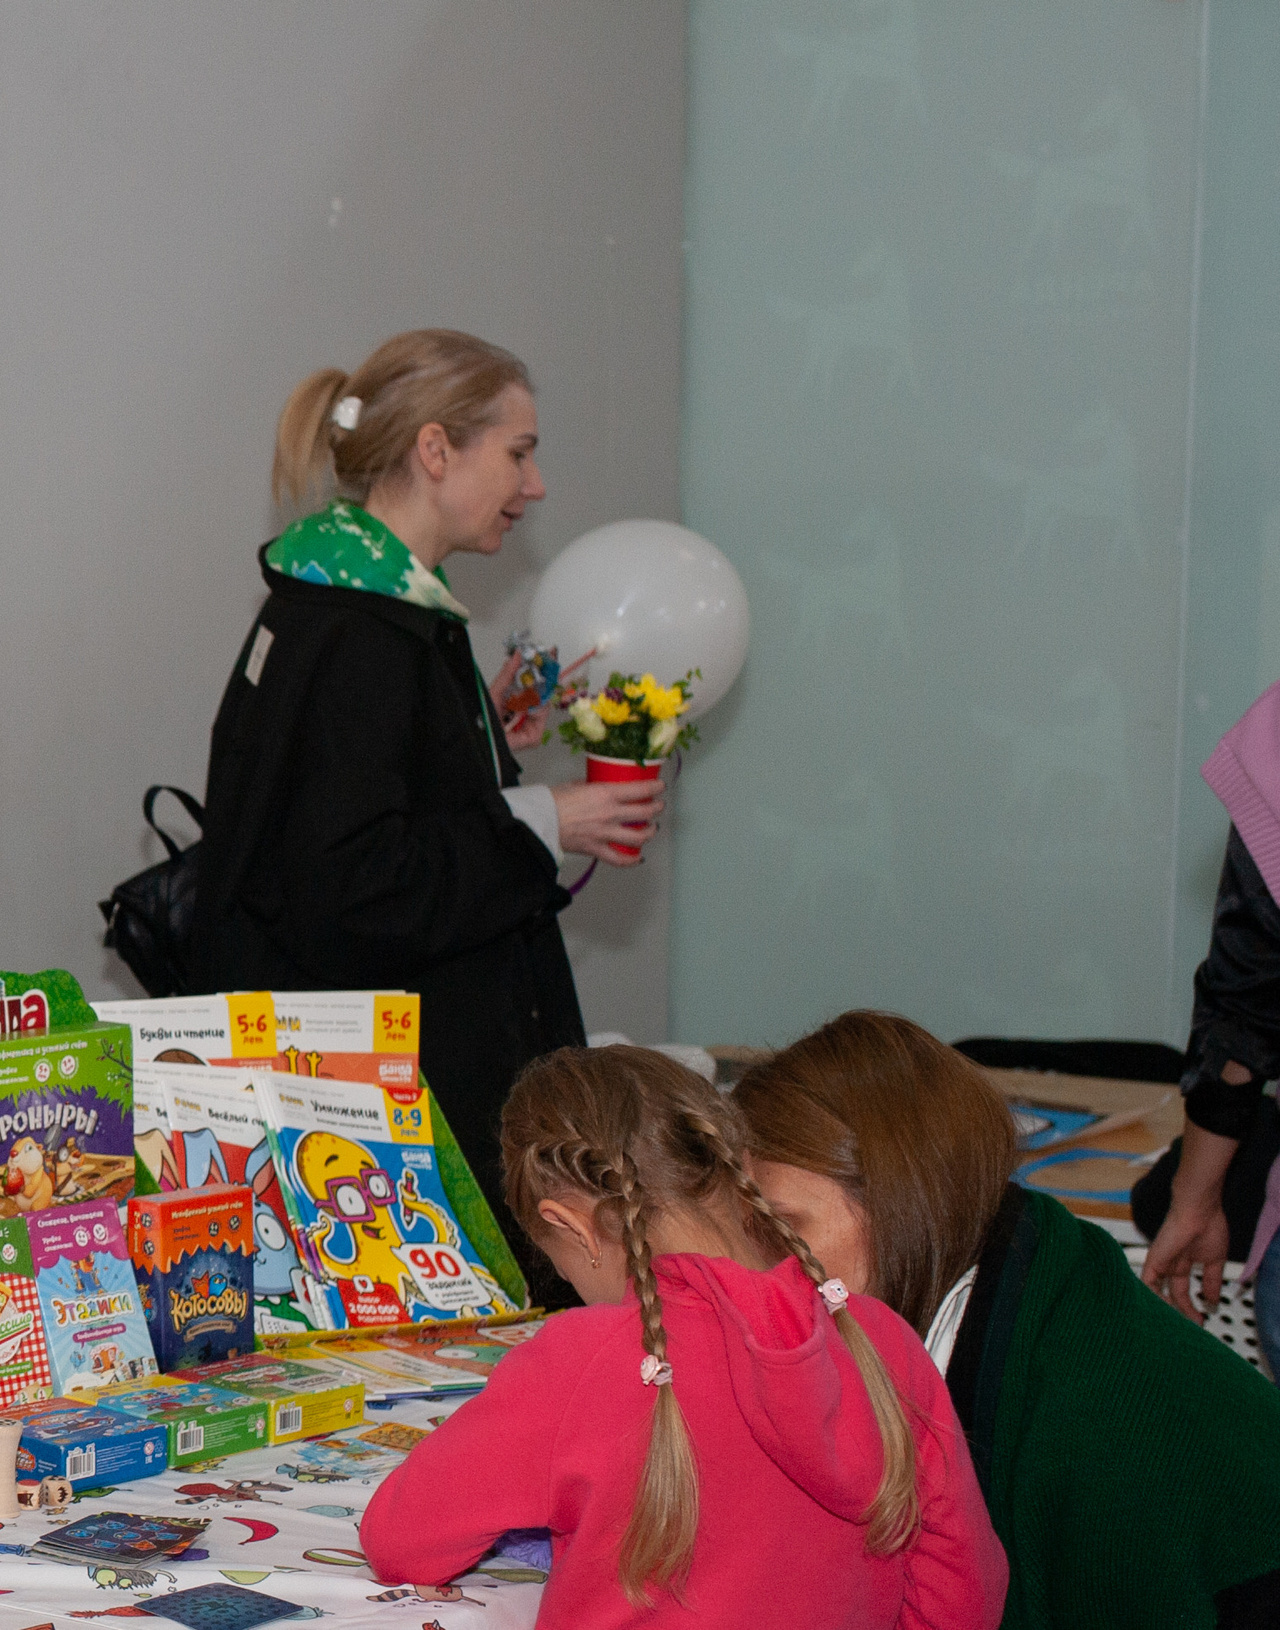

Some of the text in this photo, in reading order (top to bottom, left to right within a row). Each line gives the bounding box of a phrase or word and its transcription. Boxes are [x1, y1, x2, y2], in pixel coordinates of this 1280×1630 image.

[139, 1028, 225, 1042] Буквы и чтение
[208, 1108, 248, 1123] Весёлый
[310, 1100, 379, 1120] Умножение
[409, 1249, 460, 1279] 90
[170, 1288, 247, 1332] КОТОСОВЫ
